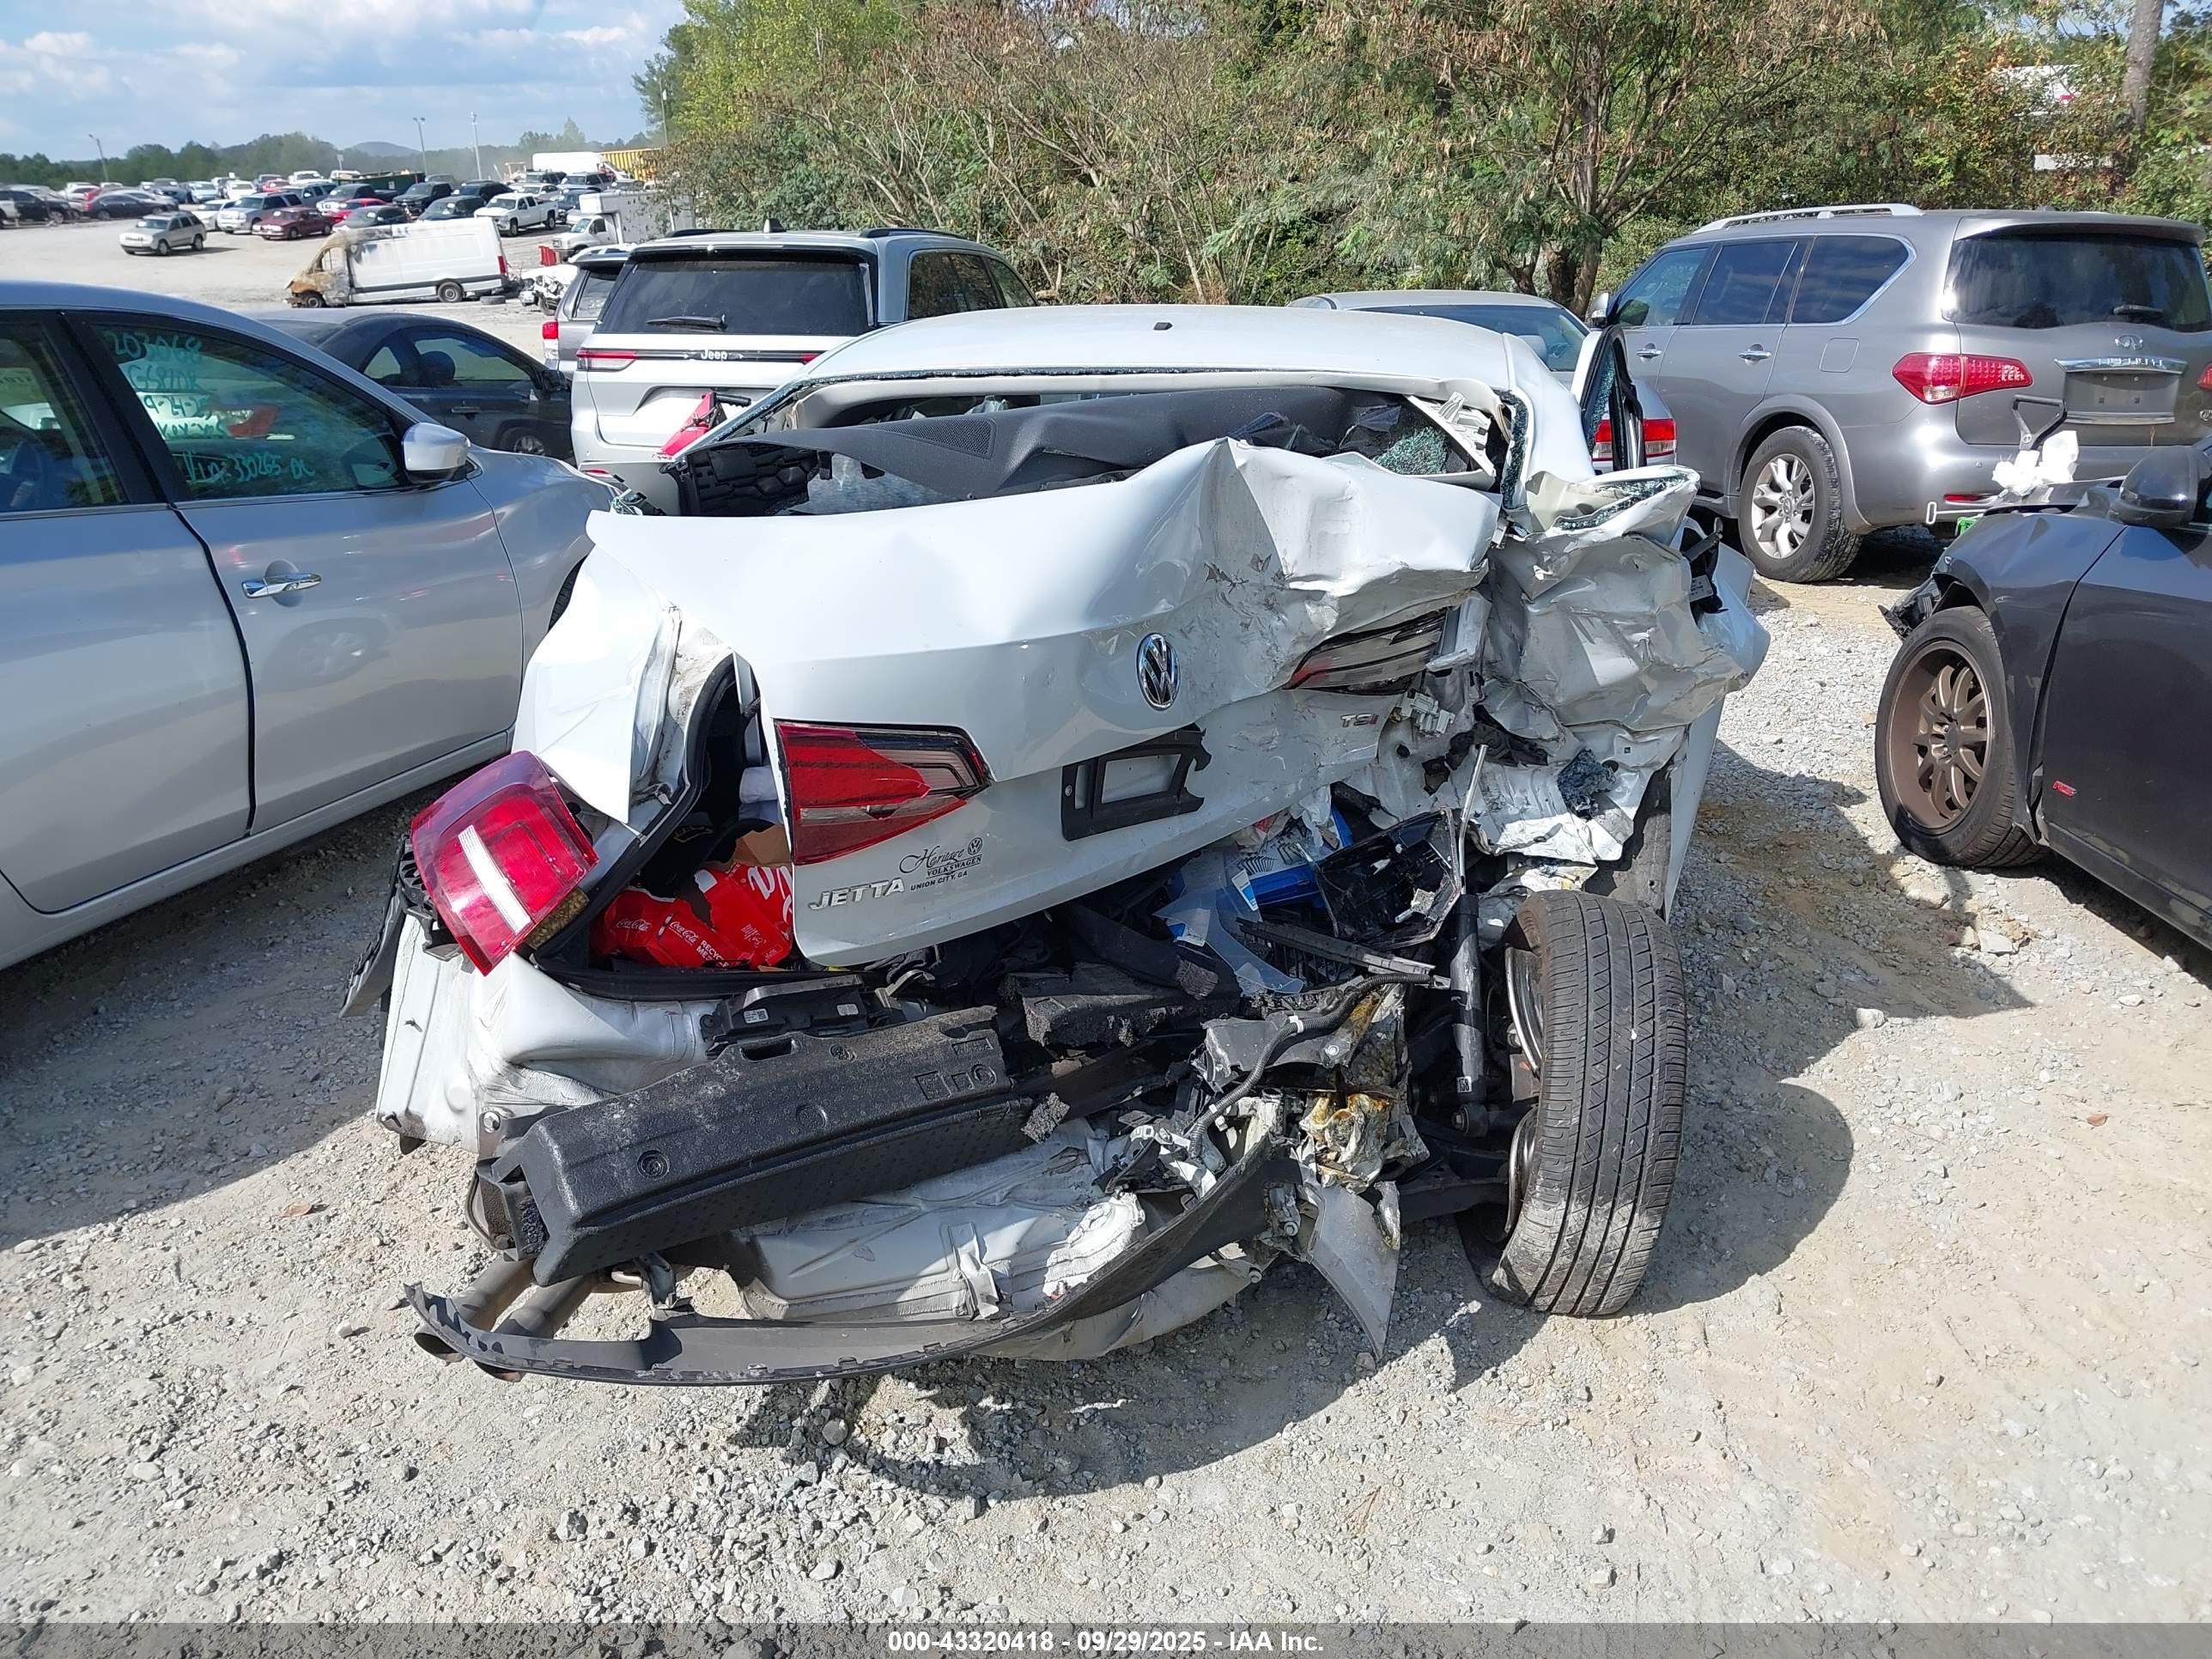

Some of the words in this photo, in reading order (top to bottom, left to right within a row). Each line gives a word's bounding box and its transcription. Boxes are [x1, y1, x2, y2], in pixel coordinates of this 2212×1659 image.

[700, 349, 728, 362] Jeep
[1340, 713, 1379, 728] TSI
[927, 857, 981, 877] VOLKSWAGEN
[910, 879, 936, 891] UNION
[957, 870, 968, 879] GA
[807, 877, 906, 910] JETTA
